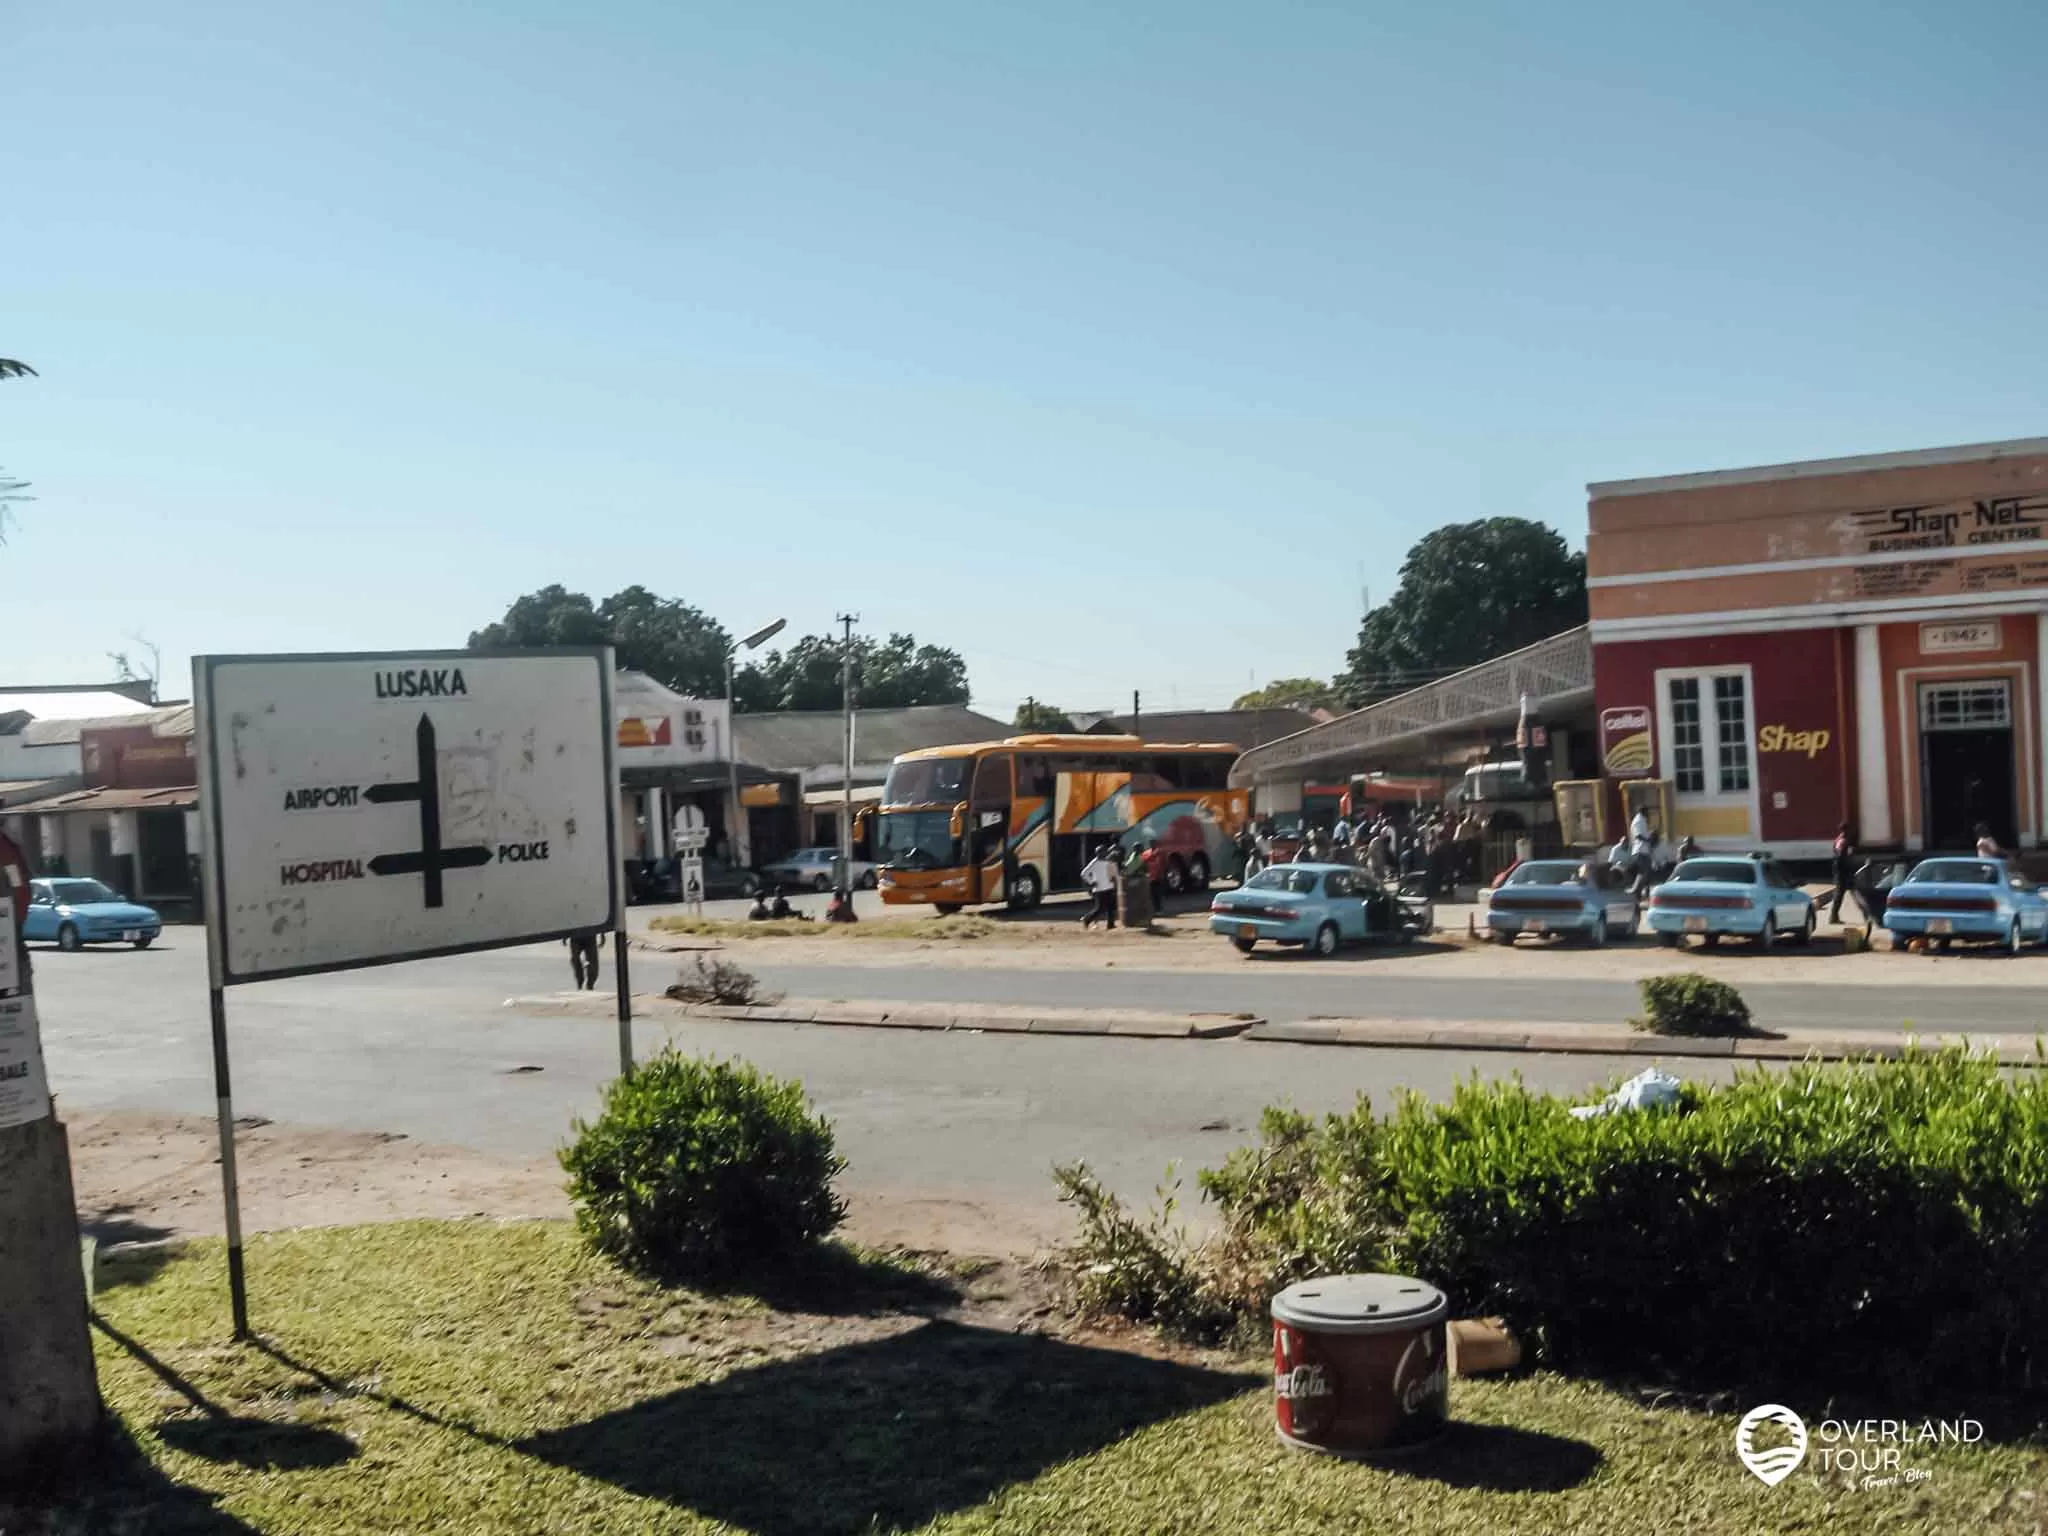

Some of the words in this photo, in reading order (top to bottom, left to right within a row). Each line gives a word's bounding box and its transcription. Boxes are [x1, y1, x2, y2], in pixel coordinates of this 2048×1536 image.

[1968, 527, 2041, 545] CENTRE
[374, 667, 468, 699] LUSAKA
[1758, 724, 1831, 760] Shap
[283, 785, 360, 811] AIRPORT
[497, 841, 550, 863] POLICE
[280, 859, 365, 886] HOSPITAL
